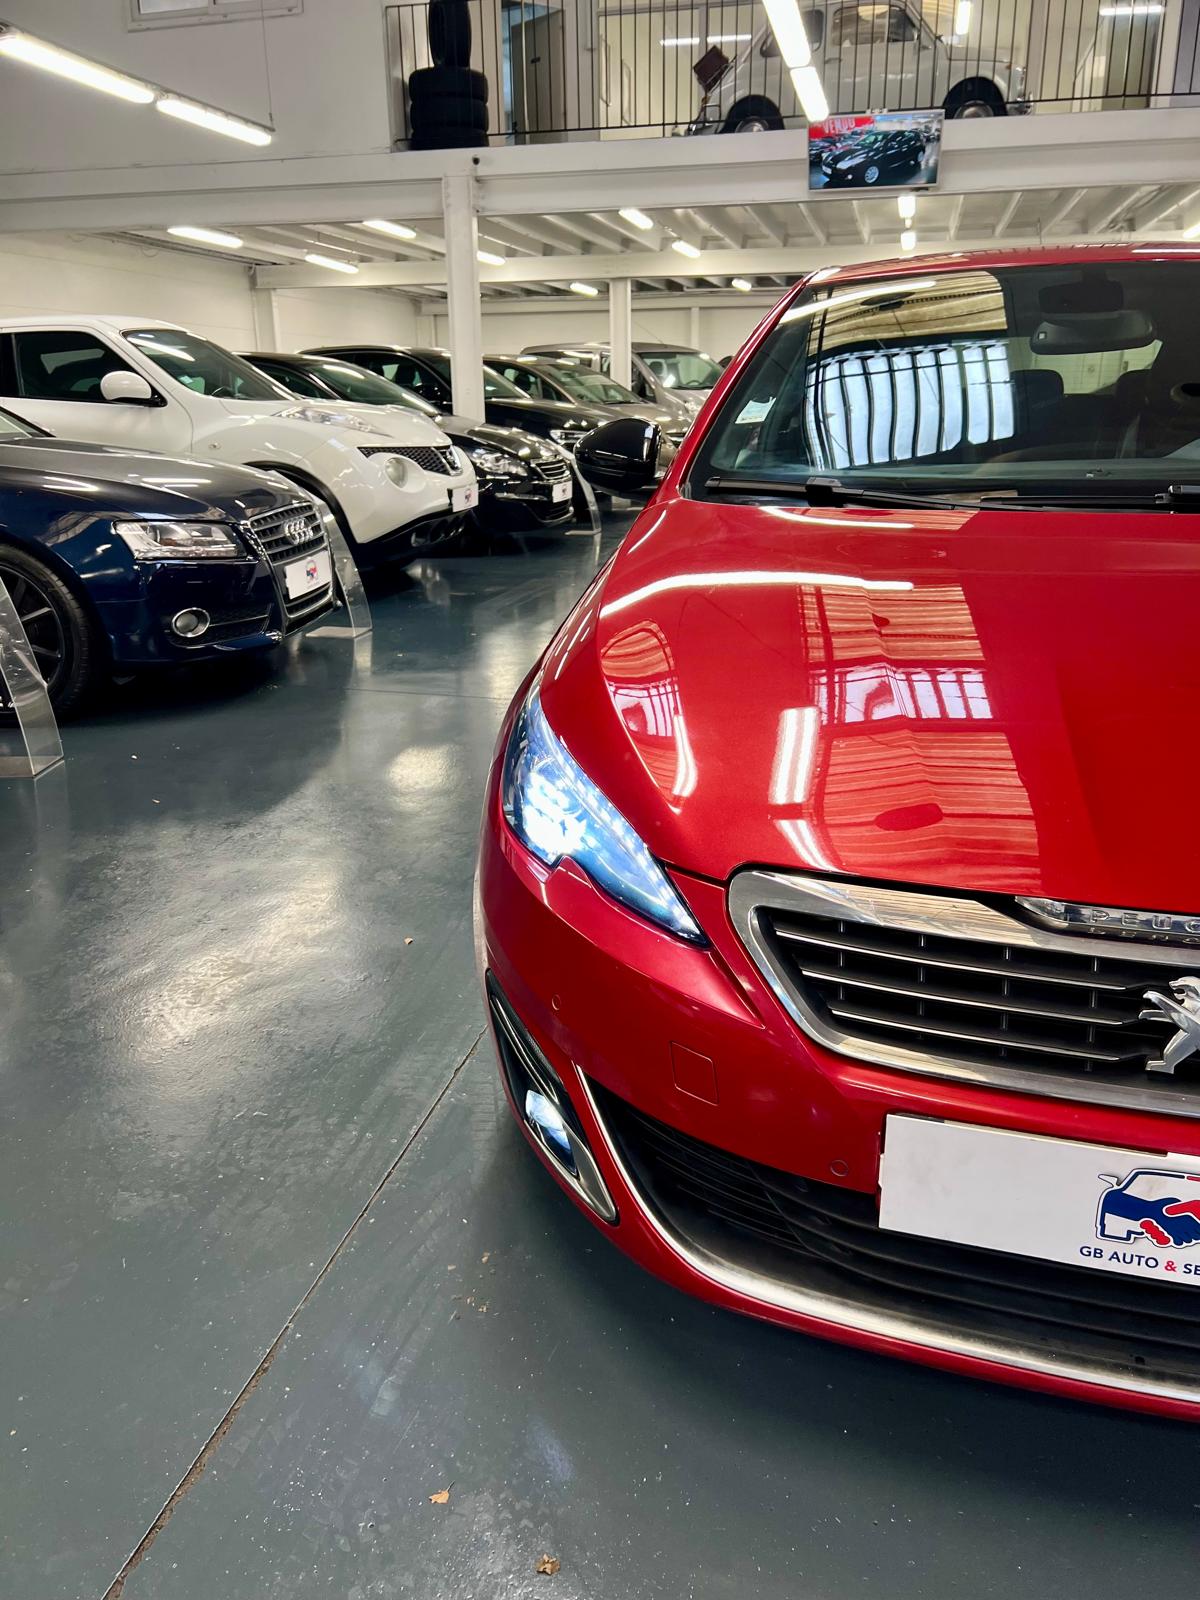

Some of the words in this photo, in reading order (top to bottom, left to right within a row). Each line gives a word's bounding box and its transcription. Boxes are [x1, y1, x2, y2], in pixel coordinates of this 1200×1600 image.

[1079, 1245, 1104, 1259] GB
[1108, 1251, 1159, 1269] AUTO
[1164, 1260, 1177, 1273] &
